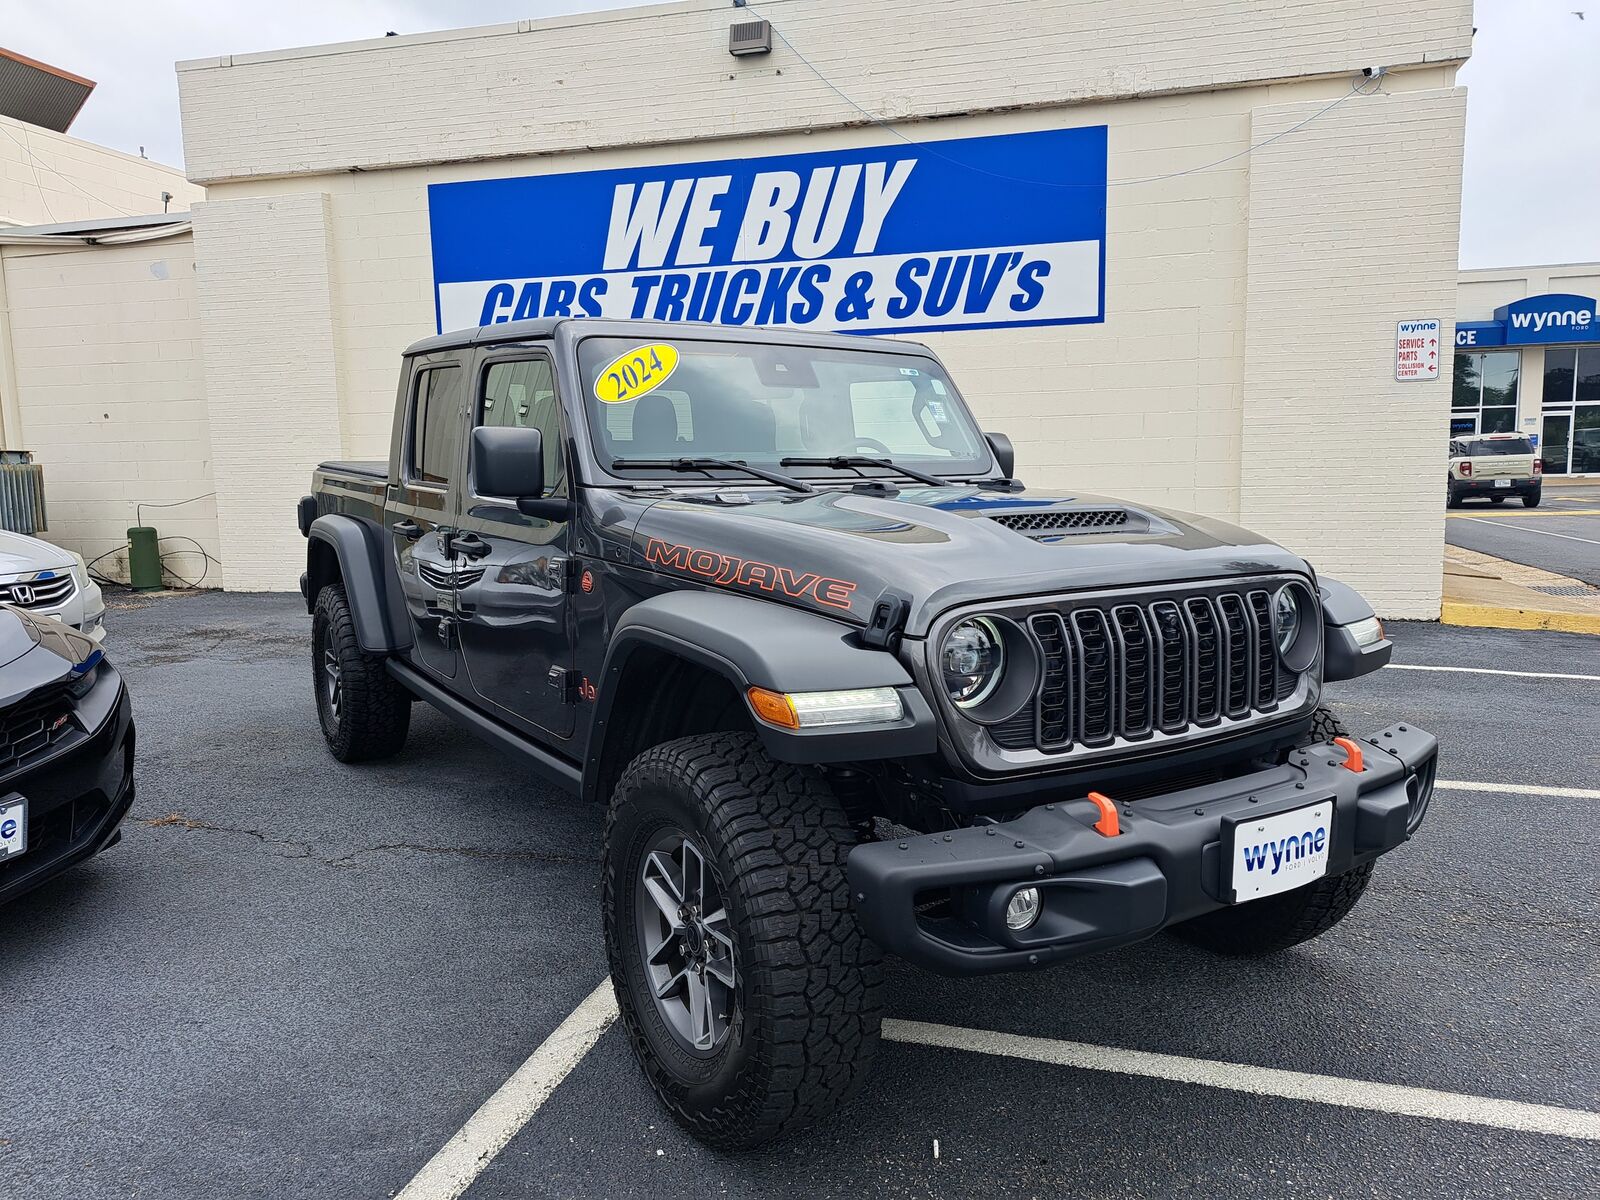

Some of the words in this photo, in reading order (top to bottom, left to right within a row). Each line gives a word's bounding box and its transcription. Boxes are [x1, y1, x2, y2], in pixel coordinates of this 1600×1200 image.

[602, 175, 733, 271] WE
[731, 159, 918, 261] BUY
[478, 278, 608, 327] CARS
[630, 264, 831, 326] TRUCKS
[834, 271, 875, 322] &
[1400, 322, 1437, 333] wynne
[1511, 309, 1591, 332] wynne
[1398, 338, 1425, 349] SERVICE
[1398, 351, 1418, 361] PARTS
[608, 347, 663, 399] 2024
[646, 538, 856, 608] MOJAVE
[1244, 827, 1325, 875] wynne
[1285, 861, 1301, 871] FORD
[1308, 852, 1324, 863] VOLVO
